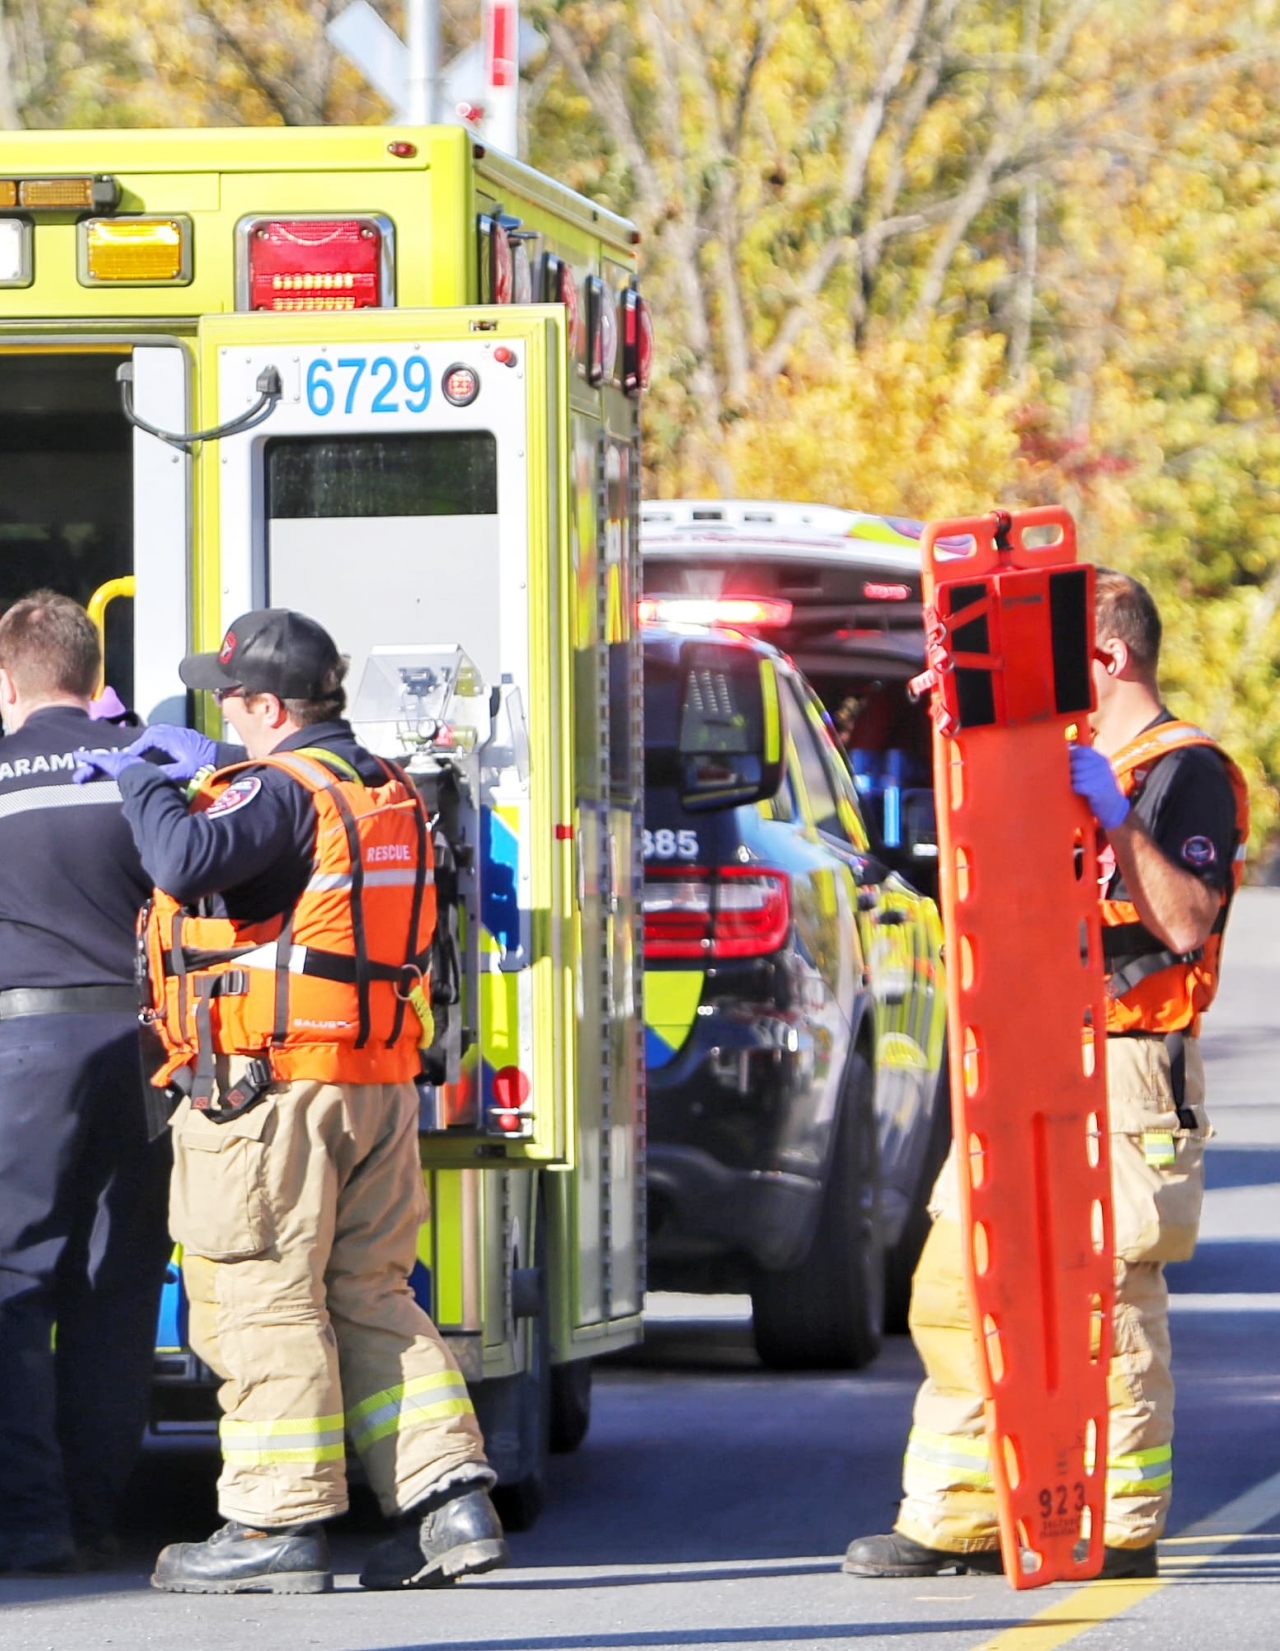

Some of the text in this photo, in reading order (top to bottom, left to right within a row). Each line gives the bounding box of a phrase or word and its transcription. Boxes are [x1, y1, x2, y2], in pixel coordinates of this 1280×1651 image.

[306, 354, 433, 417] 6729
[366, 844, 412, 863] RESCUE
[1038, 1481, 1086, 1518] 923
